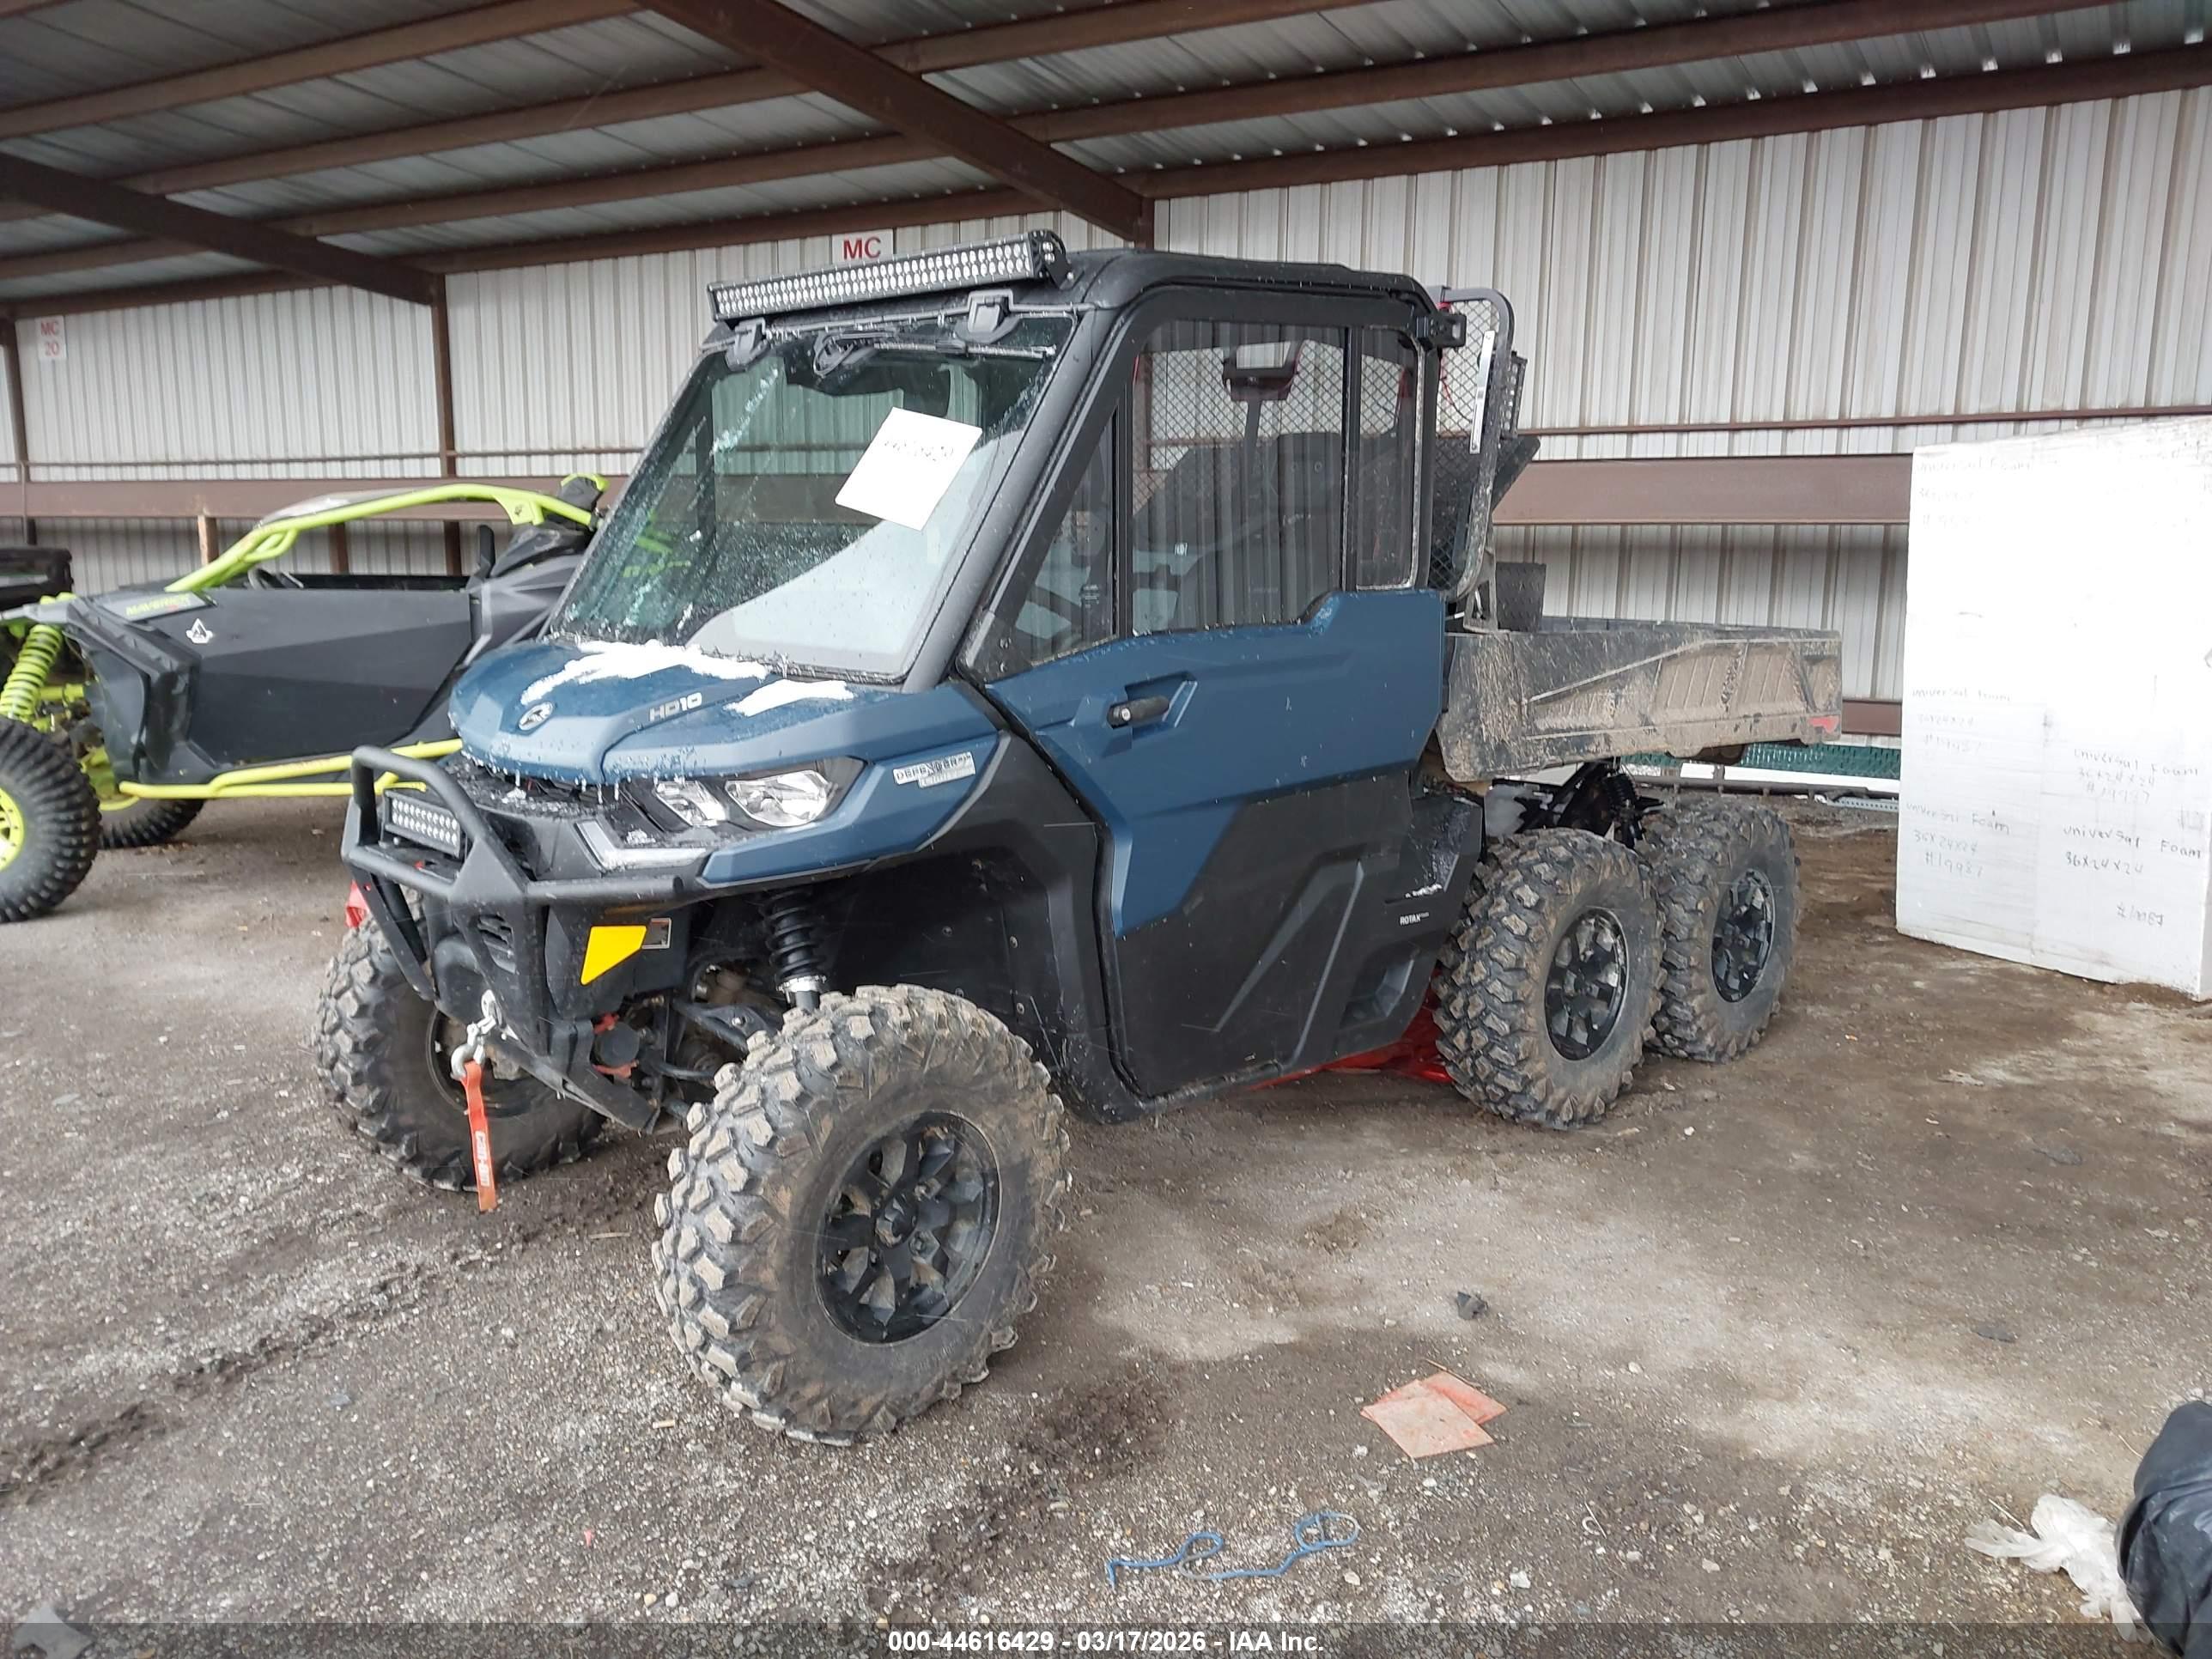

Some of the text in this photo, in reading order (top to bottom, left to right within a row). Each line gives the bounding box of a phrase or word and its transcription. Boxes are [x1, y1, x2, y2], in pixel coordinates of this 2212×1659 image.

[843, 236, 881, 260] MC
[40, 320, 59, 336] MC
[649, 692, 702, 722] HD10
[1400, 913, 1421, 926] ROTAX
